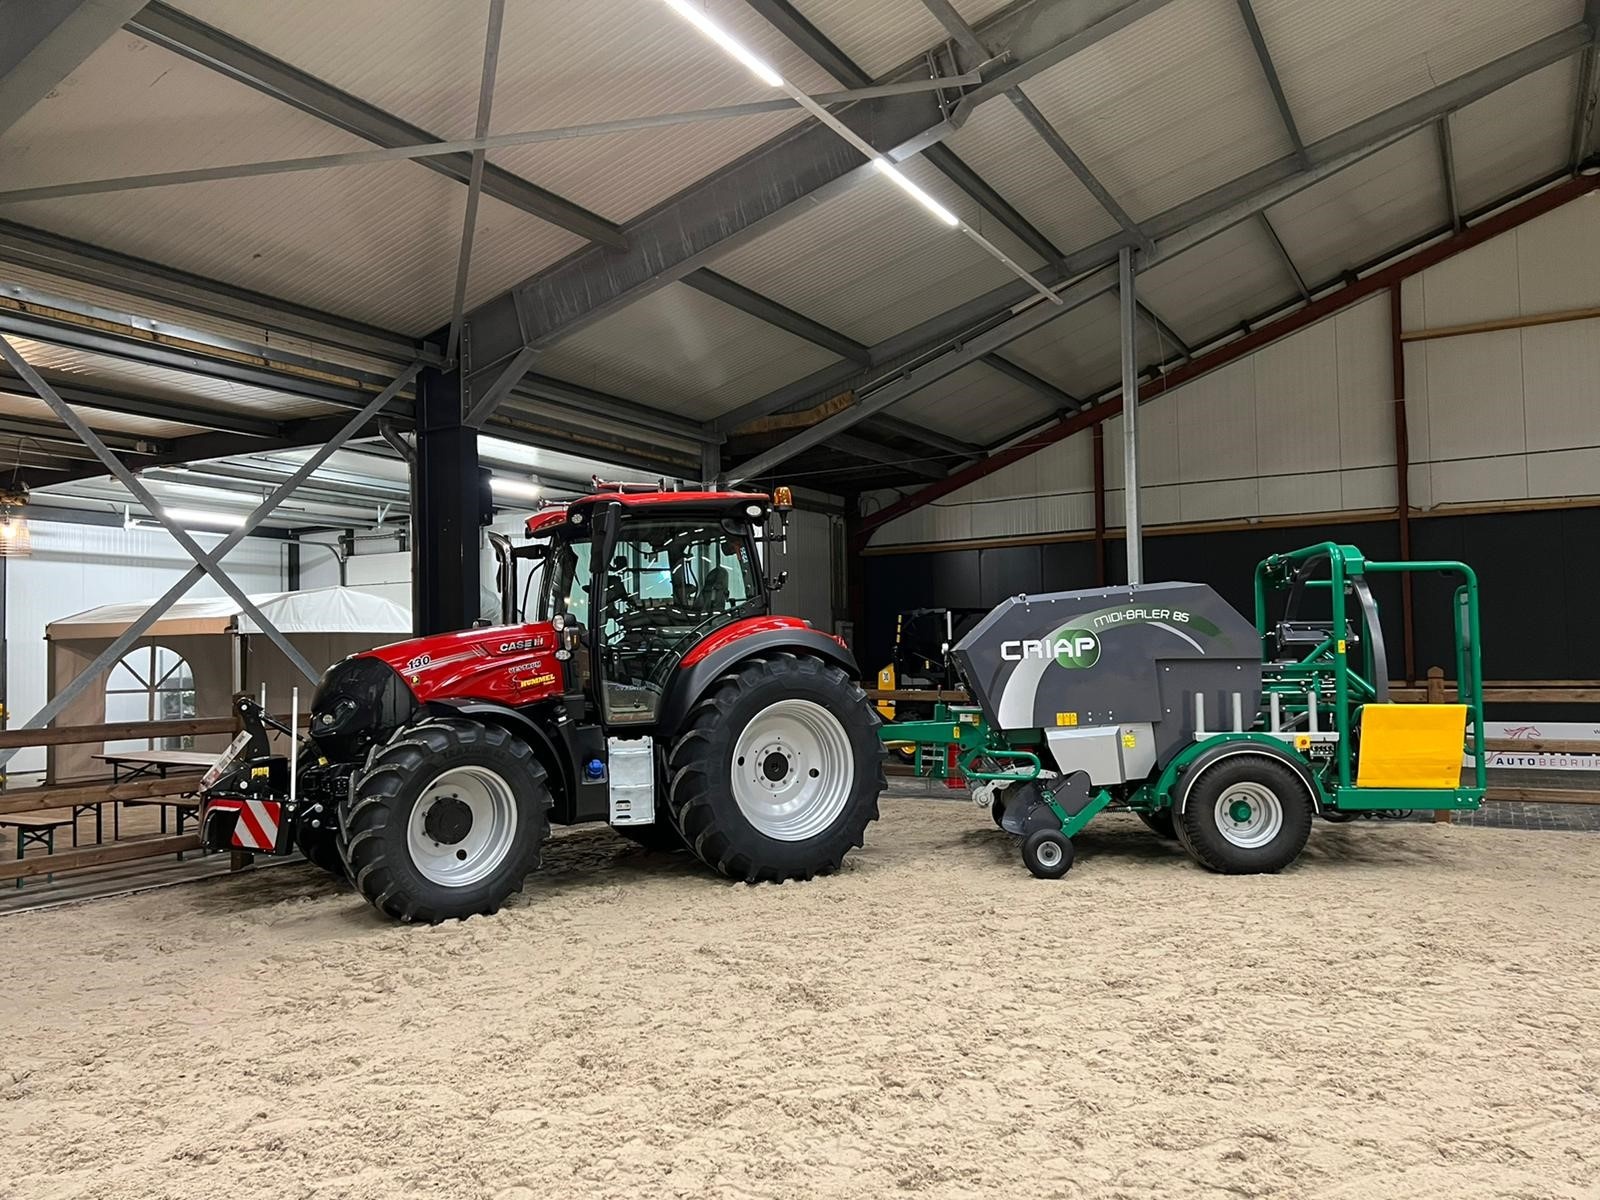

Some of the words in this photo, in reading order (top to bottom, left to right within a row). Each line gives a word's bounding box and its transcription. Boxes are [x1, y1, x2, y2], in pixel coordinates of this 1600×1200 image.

[1172, 611, 1190, 623] 85
[500, 639, 532, 652] CASE
[1000, 637, 1095, 661] CRIAP
[408, 655, 431, 670] 130
[520, 674, 555, 688] HUMMEL
